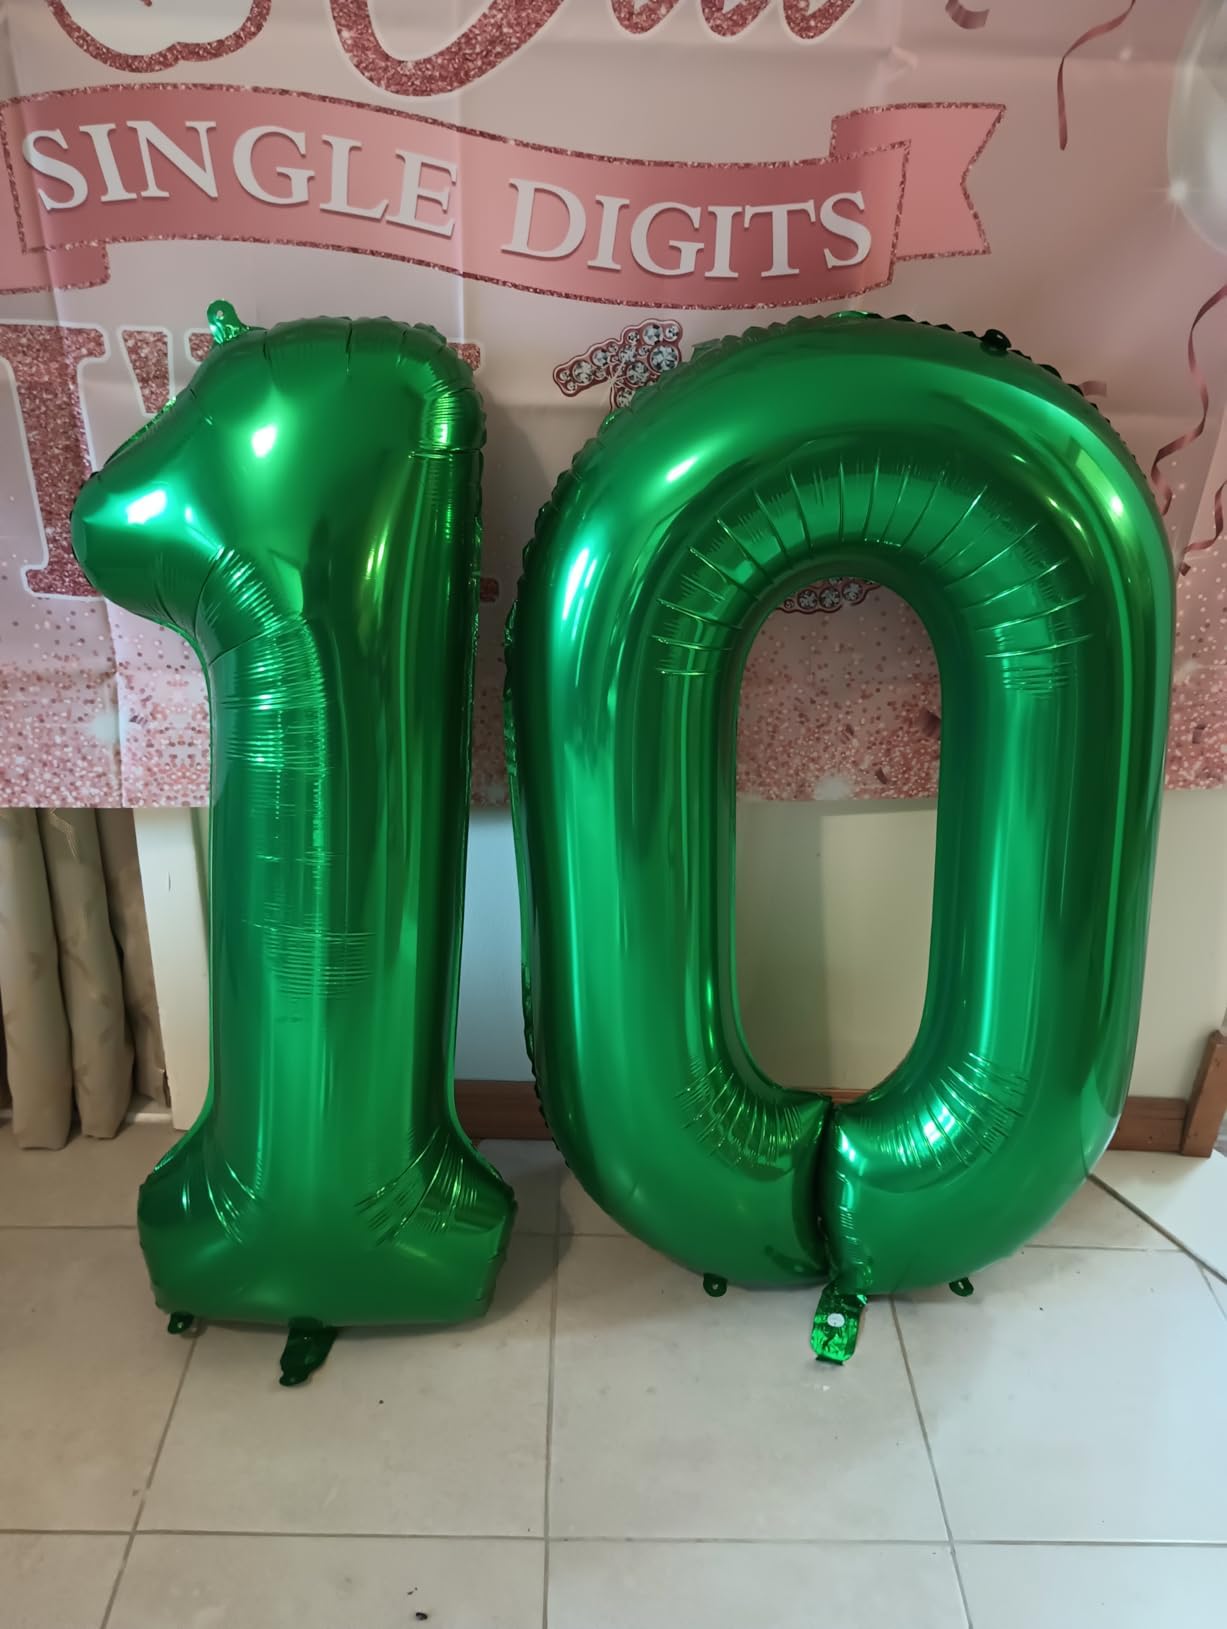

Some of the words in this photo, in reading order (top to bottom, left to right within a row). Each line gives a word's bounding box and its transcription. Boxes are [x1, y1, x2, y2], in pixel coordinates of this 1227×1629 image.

[22, 120, 459, 238] SINGLE
[500, 178, 872, 280] DIGITS
[72, 312, 1177, 1330] 10
